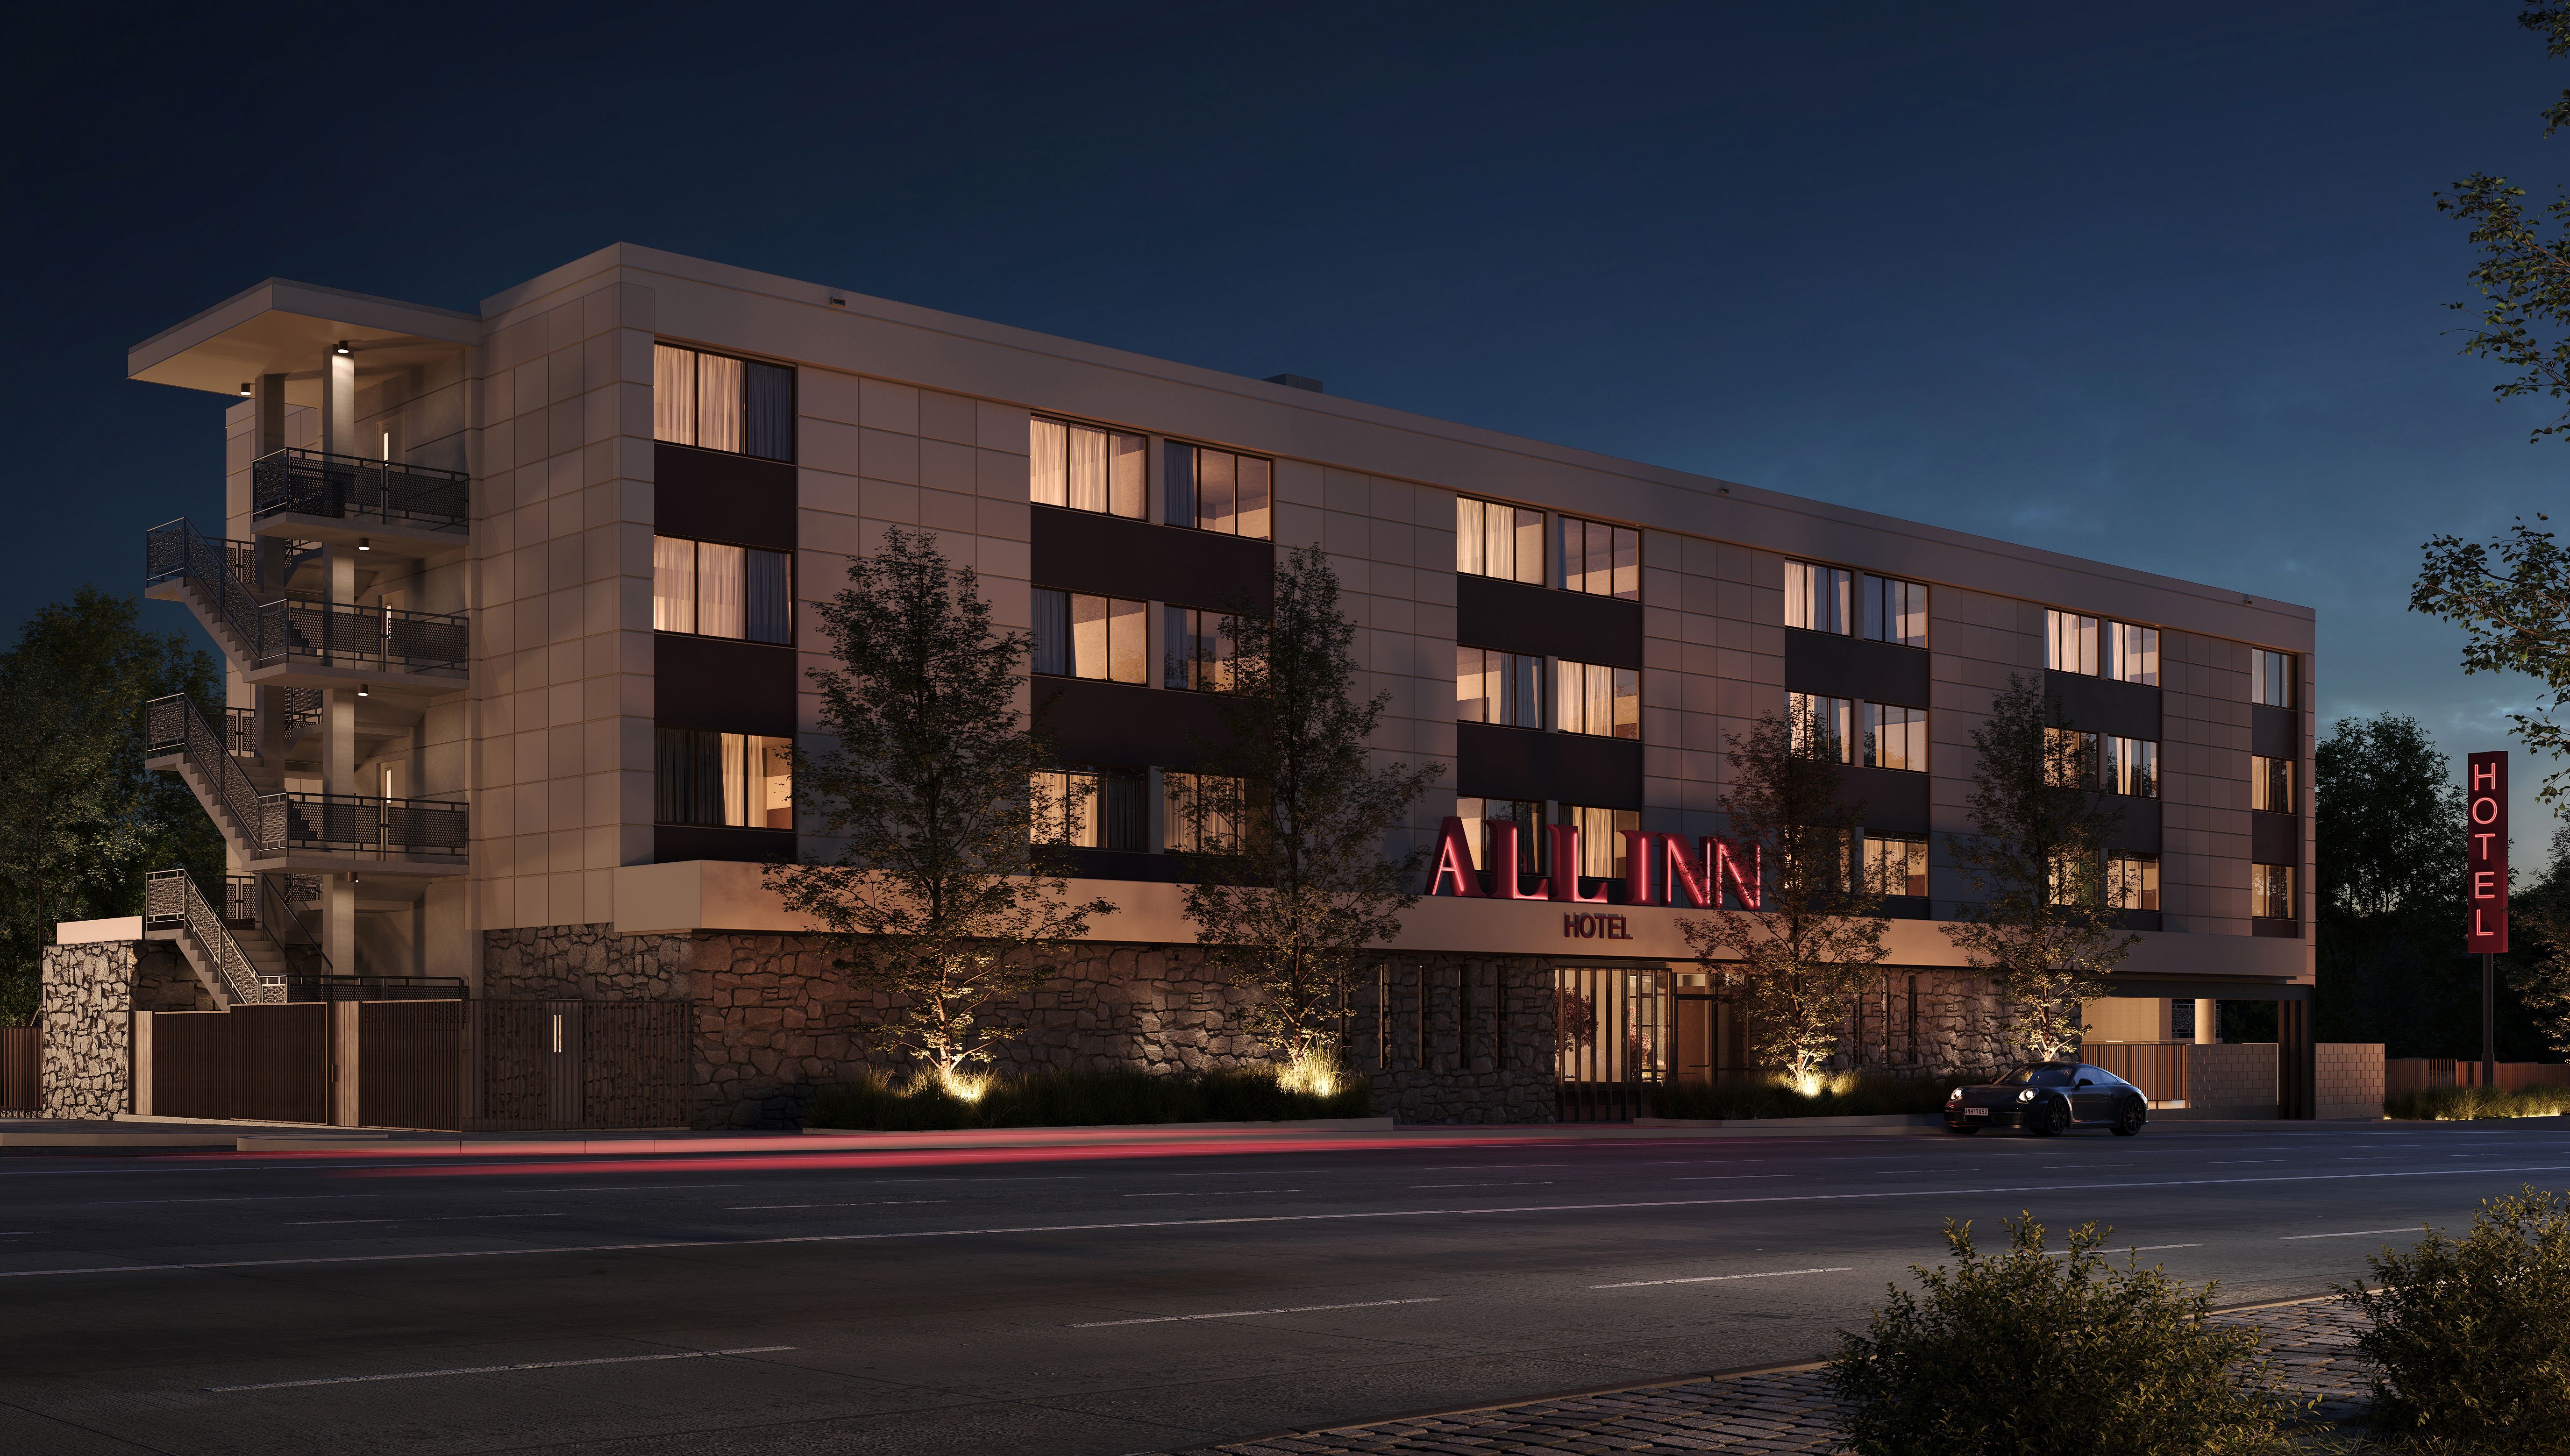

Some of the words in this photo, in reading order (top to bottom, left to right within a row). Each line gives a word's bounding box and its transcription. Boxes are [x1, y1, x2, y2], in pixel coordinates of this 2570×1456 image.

[1424, 816, 1608, 904] ALL
[1620, 830, 1760, 910] INN
[2472, 762, 2498, 936] HOTEL
[1565, 914, 1633, 940] HOTEL
